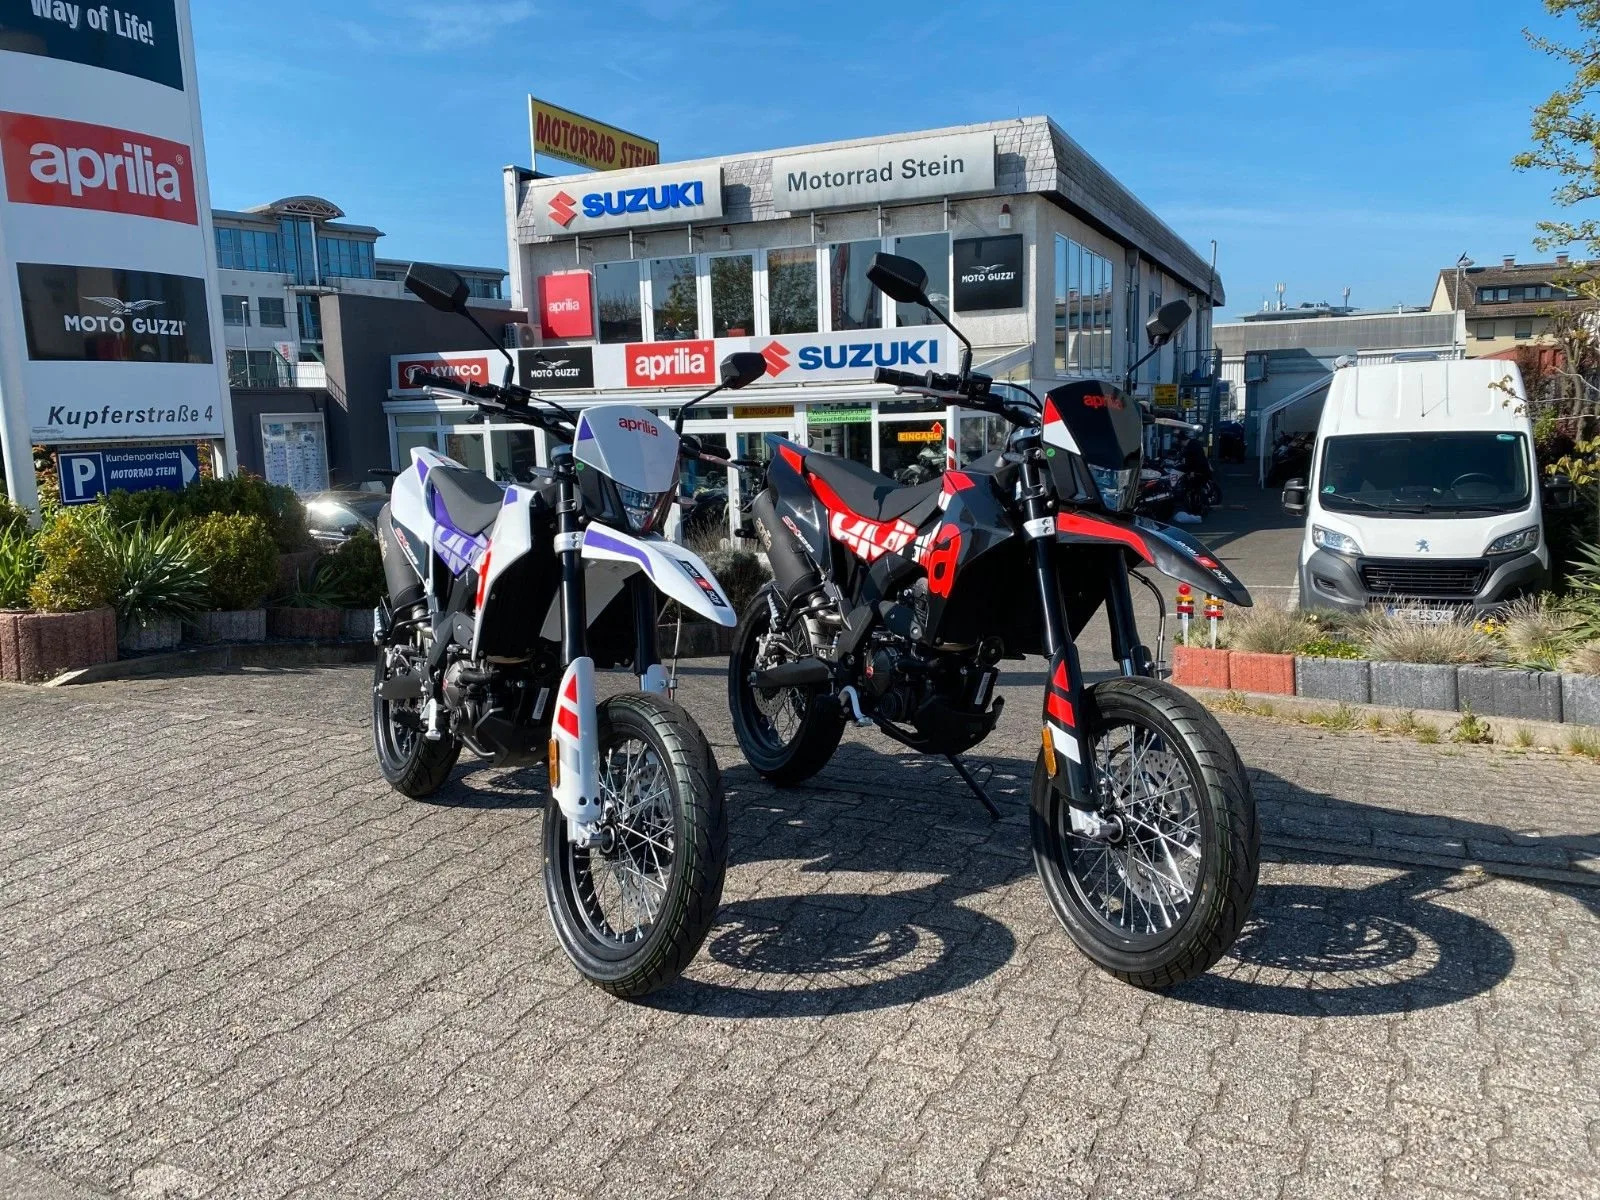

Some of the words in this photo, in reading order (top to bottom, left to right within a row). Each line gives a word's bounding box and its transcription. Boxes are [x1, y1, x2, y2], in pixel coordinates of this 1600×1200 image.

[31, 0, 79, 28] Way
[87, 8, 108, 31] of
[114, 9, 154, 46] Life!
[536, 111, 616, 165] MOTORRAD
[620, 141, 657, 168] STEIN
[29, 142, 182, 202] aprilia
[787, 161, 893, 192] Motorrad
[901, 154, 964, 179] Stein
[582, 181, 704, 218] SUZUKI
[961, 274, 985, 283] MOTO
[987, 272, 1014, 282] GUZZI
[548, 298, 580, 315] aprilia
[64, 314, 125, 333] MOTO
[132, 317, 184, 336] GUZZI
[635, 347, 706, 376] aprilia
[798, 339, 939, 370] SUZUKI
[430, 364, 482, 378] KYMCO
[531, 368, 553, 378] MOTO
[555, 367, 579, 377] GUZZI
[47, 404, 199, 430] Kupferstraße
[204, 405, 213, 422] 4
[618, 416, 659, 437] aprilia
[900, 432, 940, 440] EINGANG
[105, 451, 180, 463] Kundenparkplatz
[71, 457, 96, 497] P
[110, 468, 154, 480] MOTORRAD
[155, 466, 177, 477] STEIN
